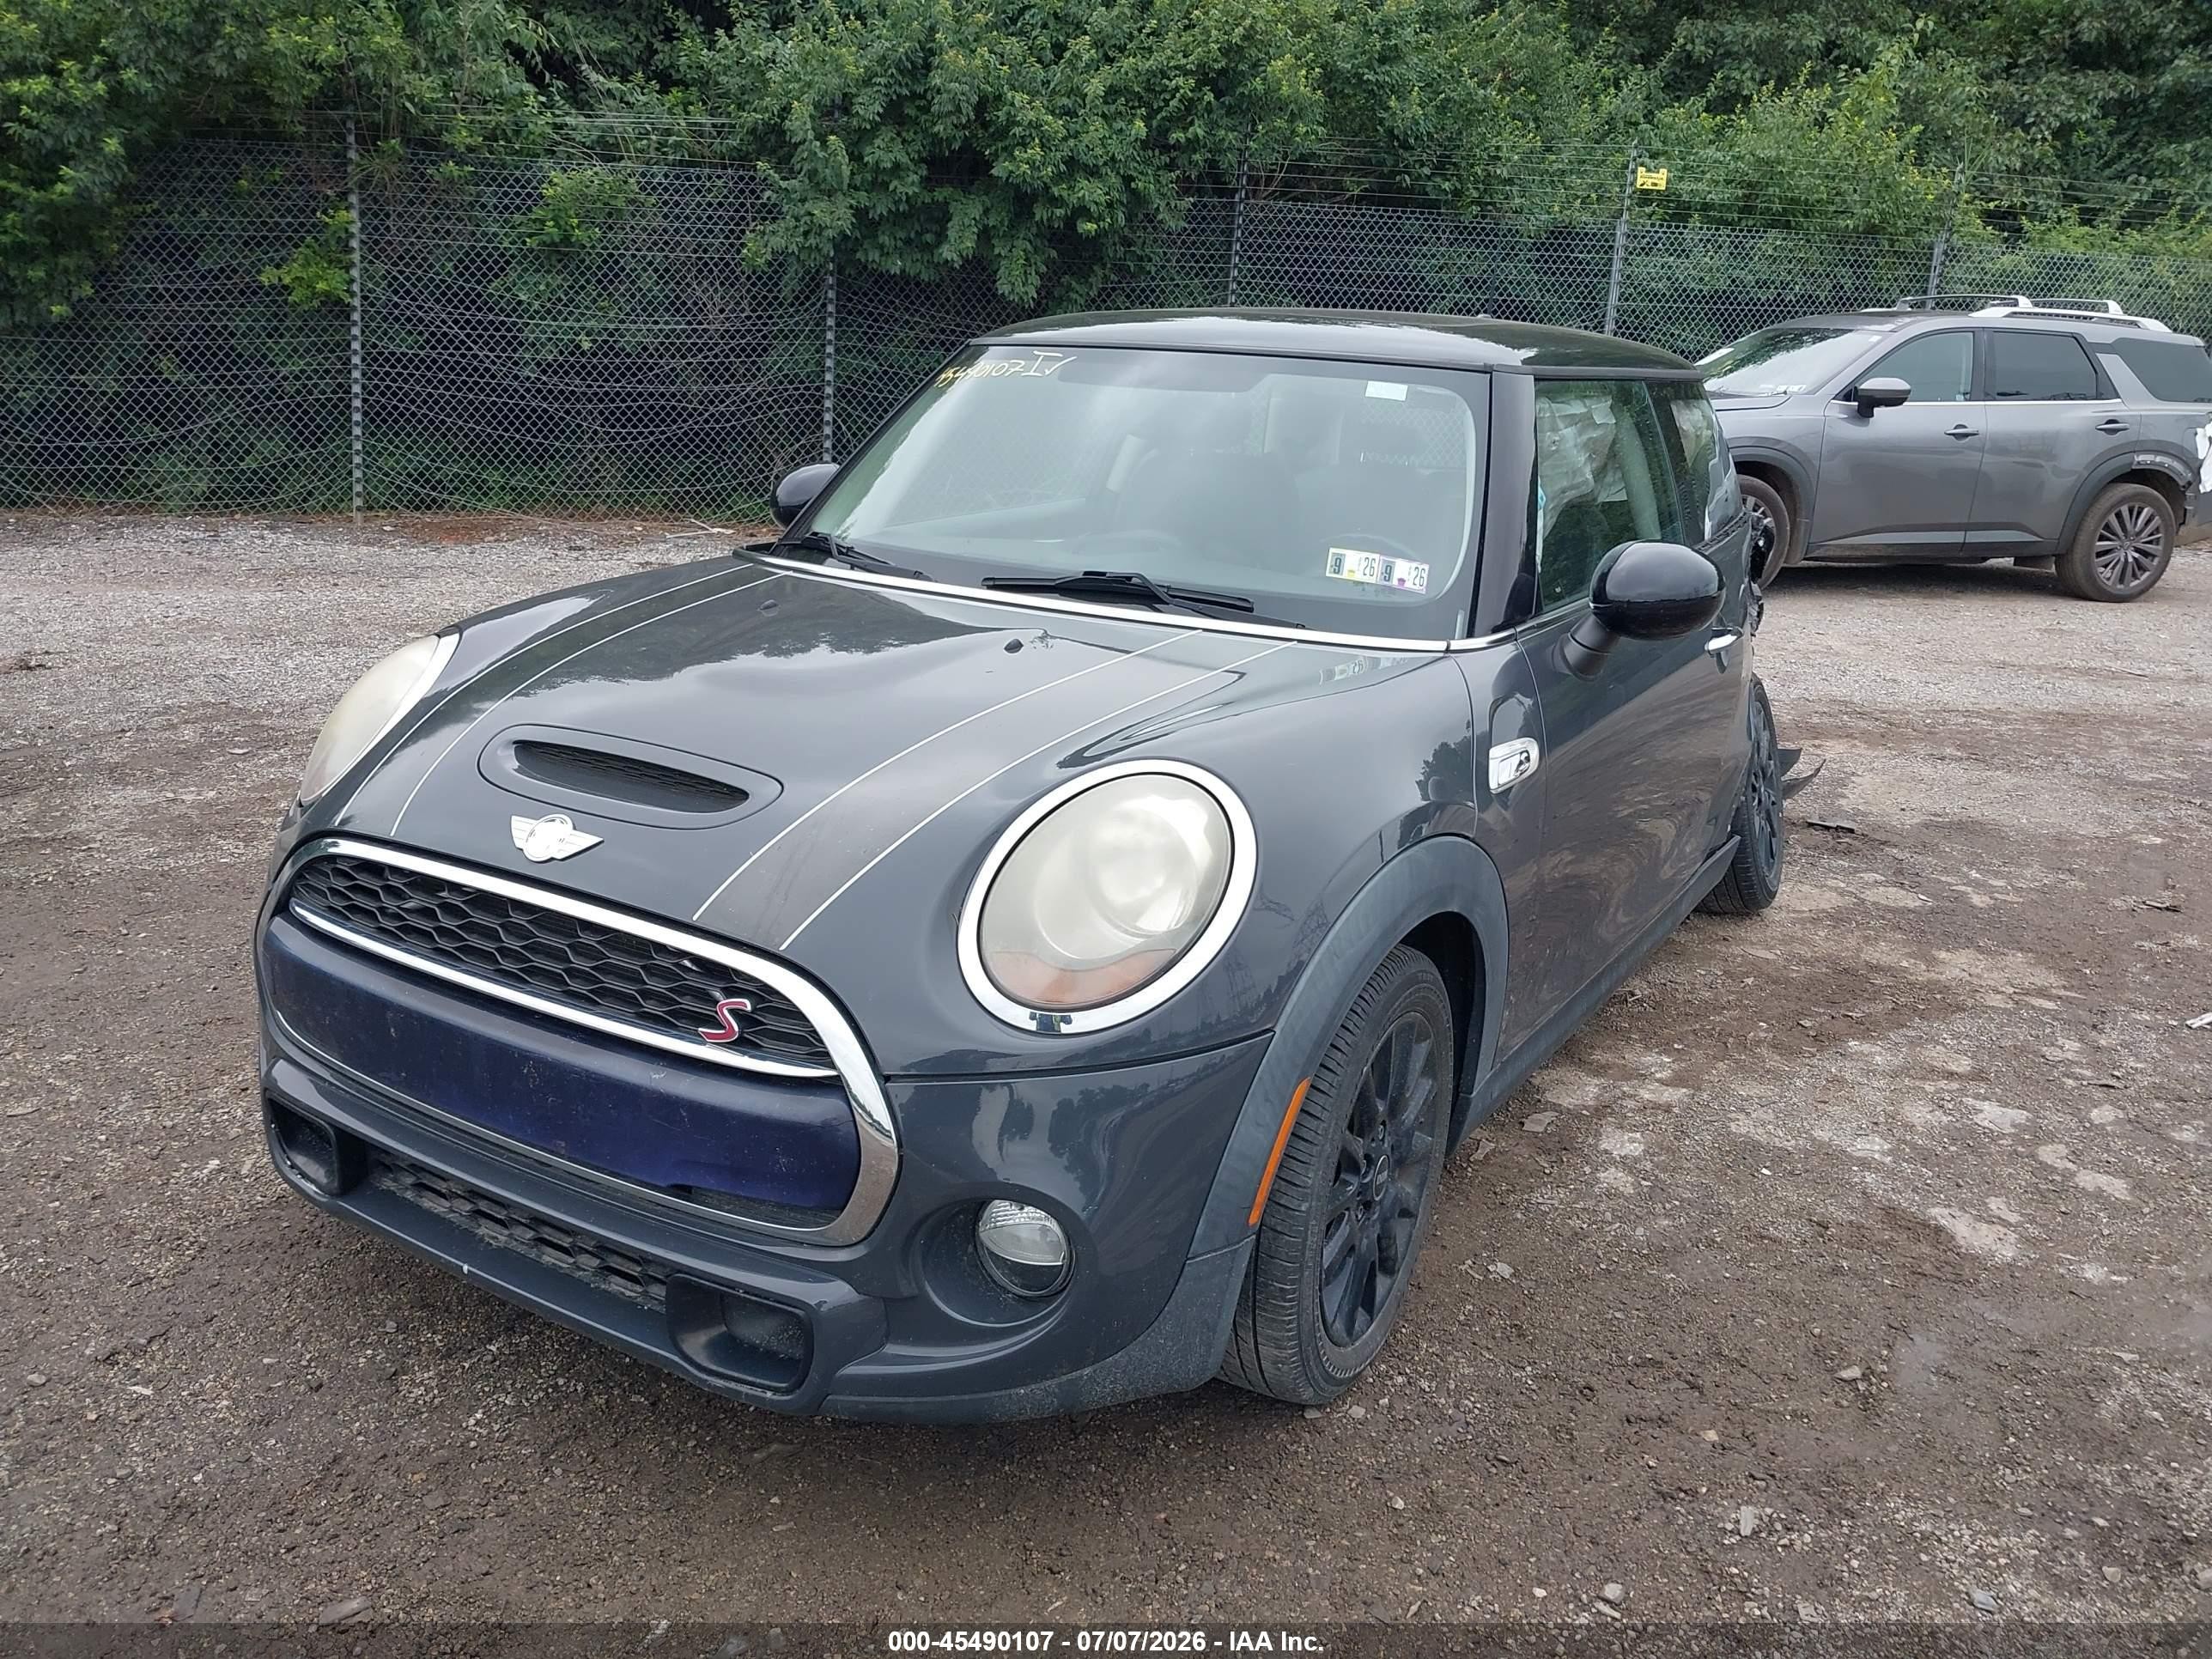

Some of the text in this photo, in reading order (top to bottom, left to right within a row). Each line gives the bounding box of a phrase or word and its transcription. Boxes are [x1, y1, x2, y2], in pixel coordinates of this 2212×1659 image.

[1333, 556, 1342, 574] 9
[1363, 556, 1376, 577] 26
[1383, 564, 1393, 582] 9
[1413, 566, 1425, 587] 26
[697, 998, 752, 1043] S
